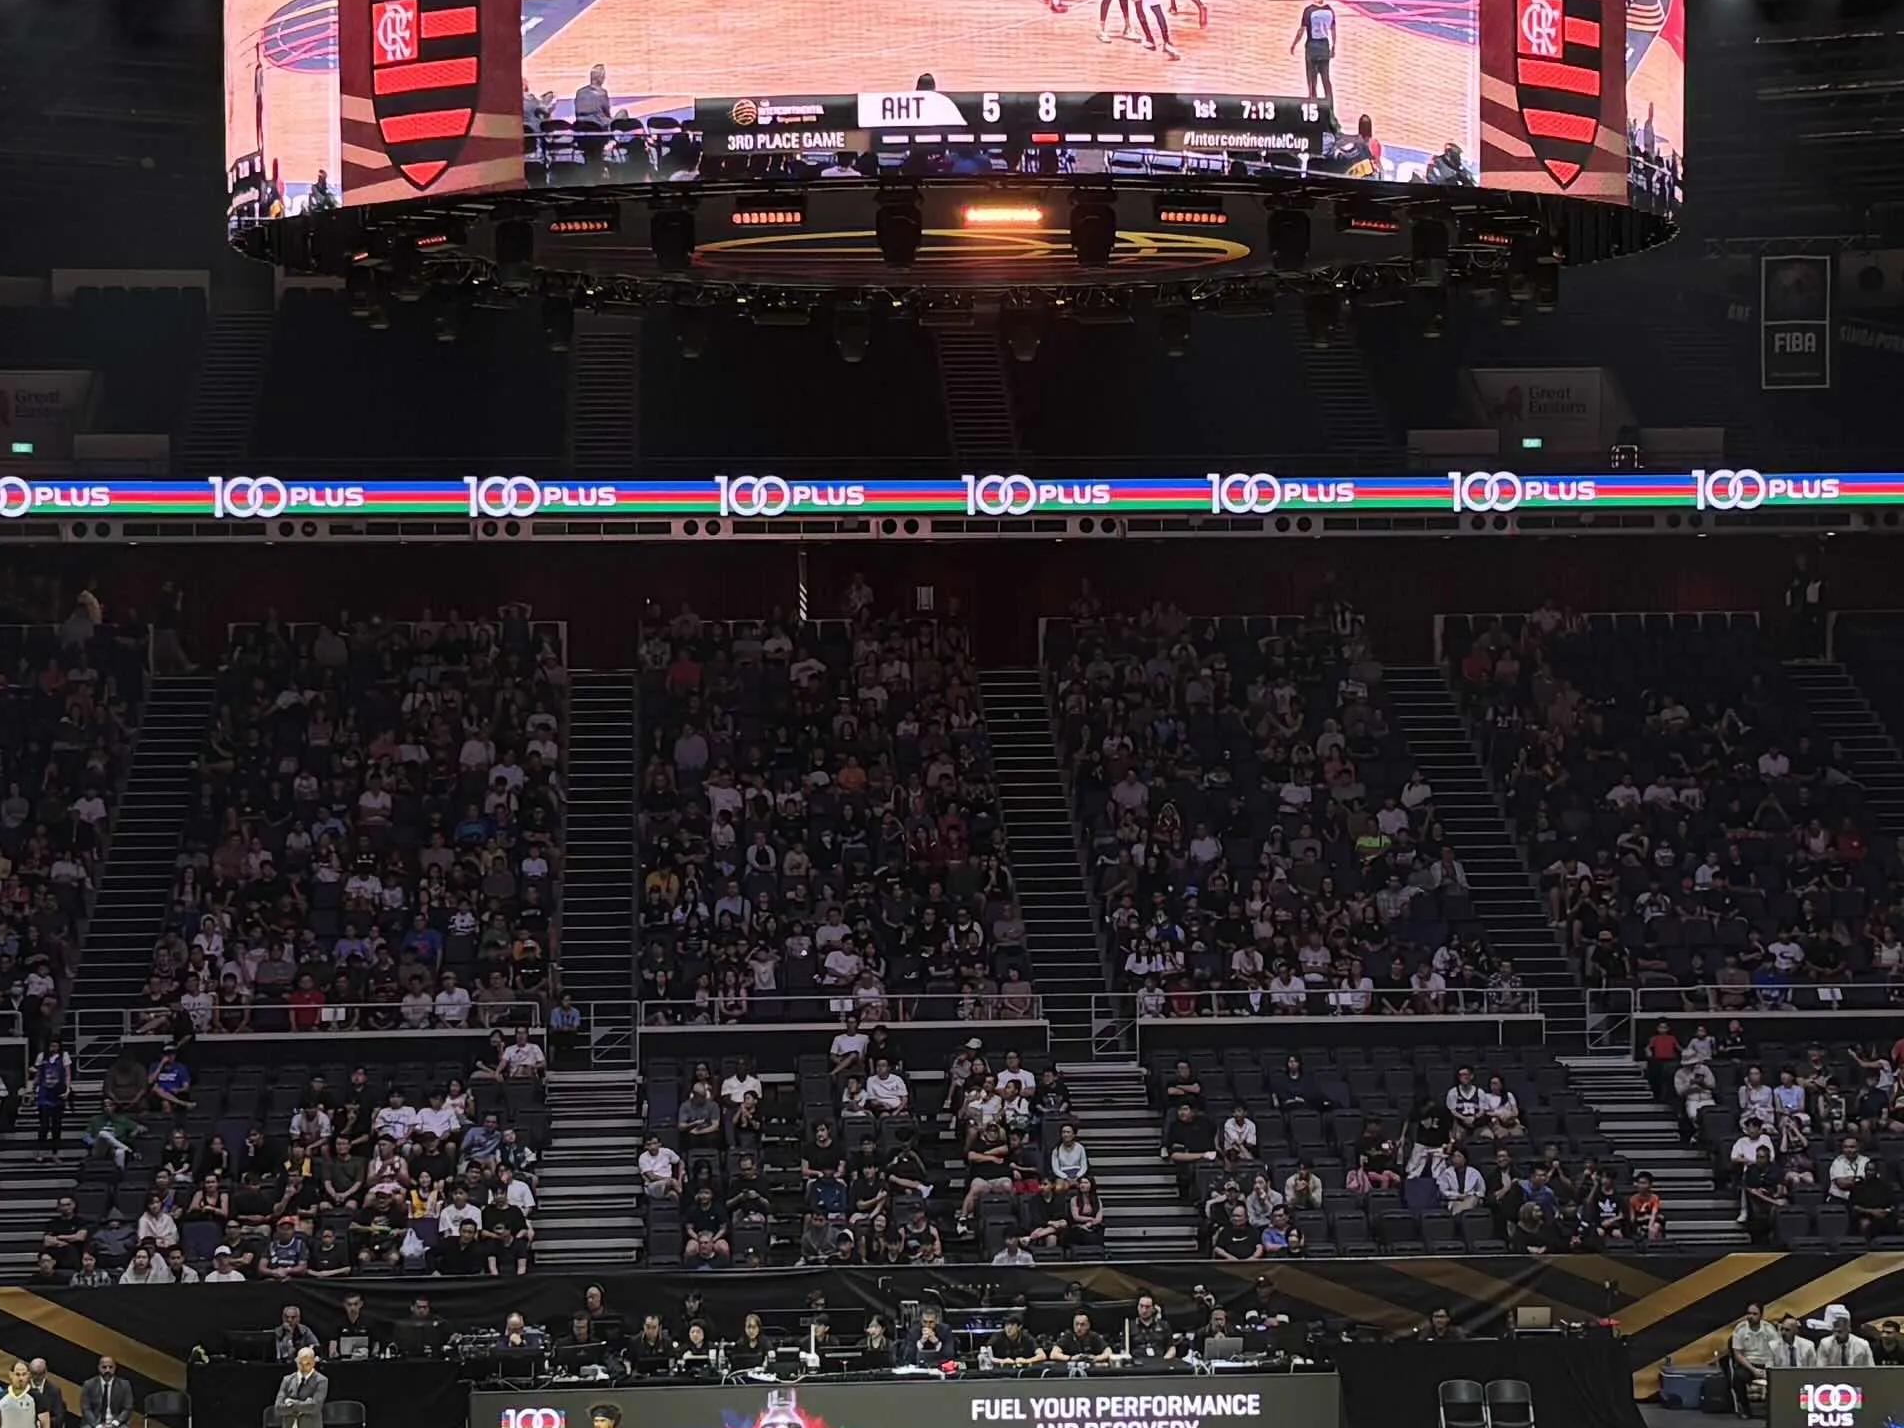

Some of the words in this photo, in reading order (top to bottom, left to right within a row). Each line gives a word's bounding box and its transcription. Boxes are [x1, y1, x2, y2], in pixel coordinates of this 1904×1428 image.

[882, 97, 925, 120] AHT
[982, 93, 1001, 122] 5
[1038, 92, 1056, 122] 8
[1113, 95, 1152, 121] FLA
[1193, 100, 1217, 119] 1st
[1241, 101, 1275, 120] 7:13
[1301, 103, 1318, 122] 15
[727, 134, 753, 151] 3RD
[757, 132, 800, 150] PLACE
[803, 131, 845, 148] GAME
[1183, 131, 1309, 151] #IntercontinentalCup
[1774, 332, 1817, 355] FIBA
[971, 1399, 1026, 1420] FUEL
[1030, 1397, 1090, 1419] YOUR
[1096, 1394, 1260, 1418] PERFORMANCE
[1802, 1383, 1858, 1411] 100
[1807, 1412, 1854, 1427] PLUS
